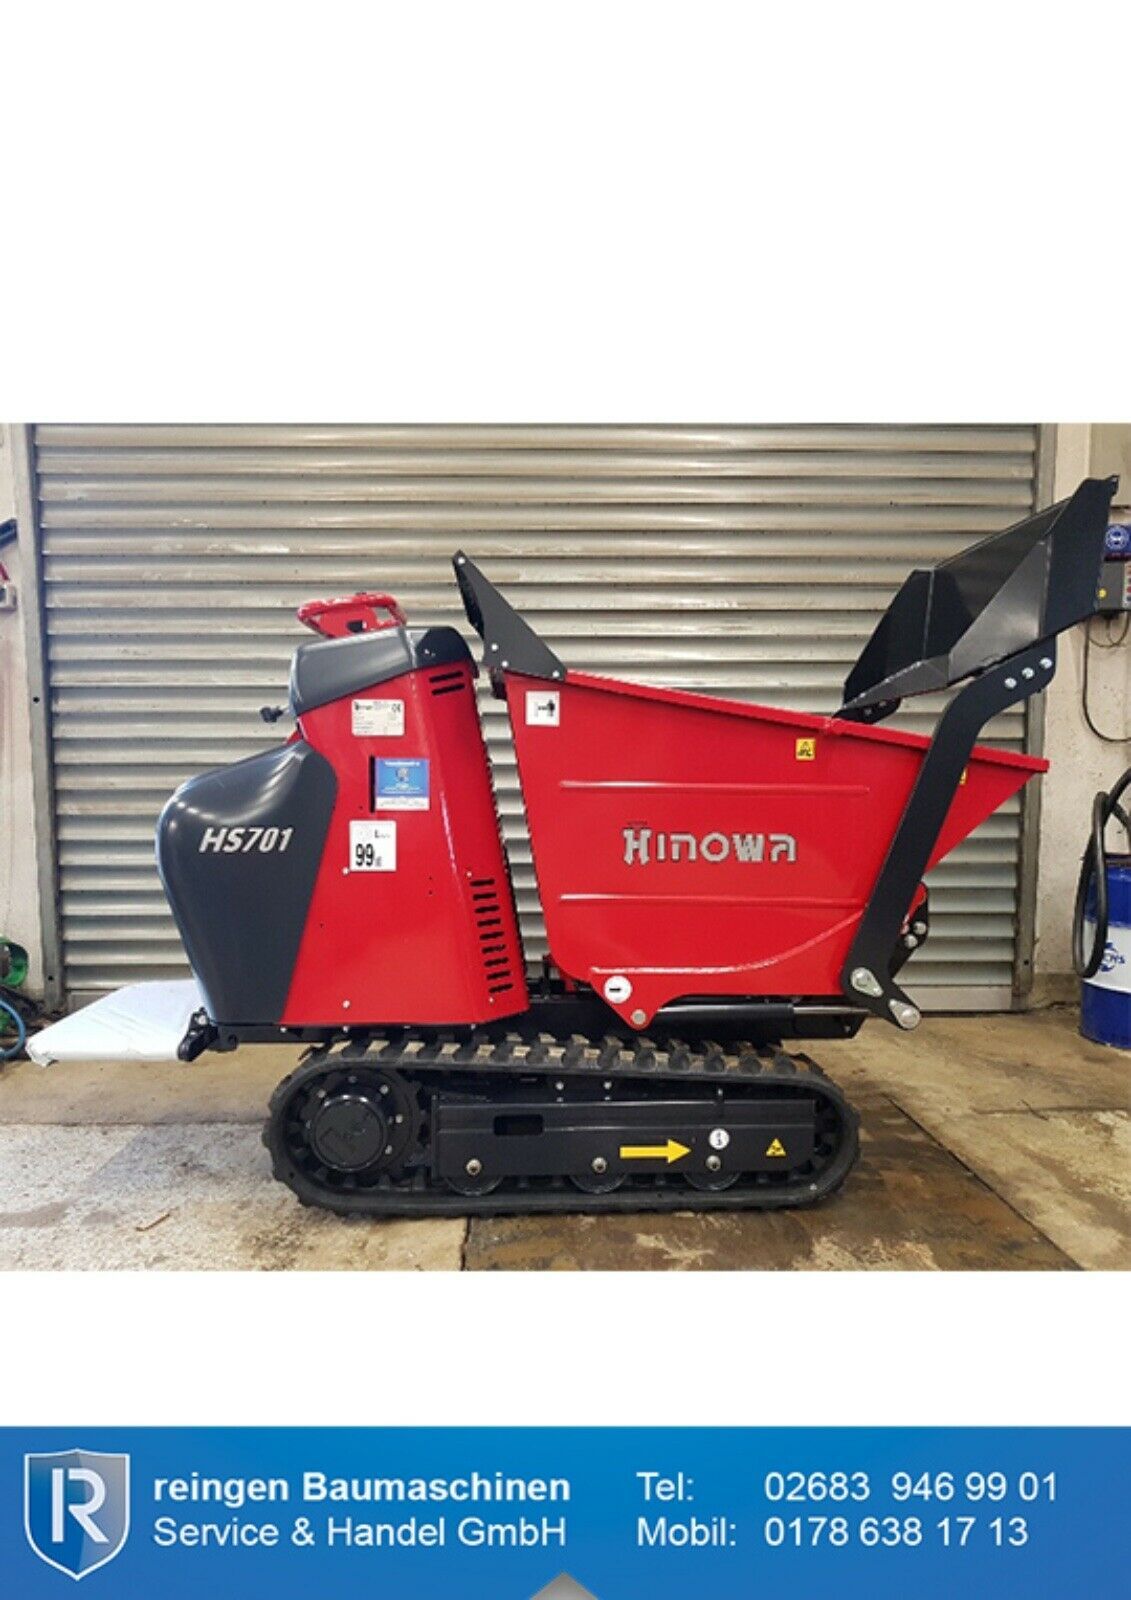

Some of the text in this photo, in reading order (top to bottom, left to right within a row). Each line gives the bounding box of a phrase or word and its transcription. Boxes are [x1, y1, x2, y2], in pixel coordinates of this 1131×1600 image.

[199, 826, 293, 853] HS701
[623, 828, 797, 865] HINOWA
[355, 842, 375, 867] 99
